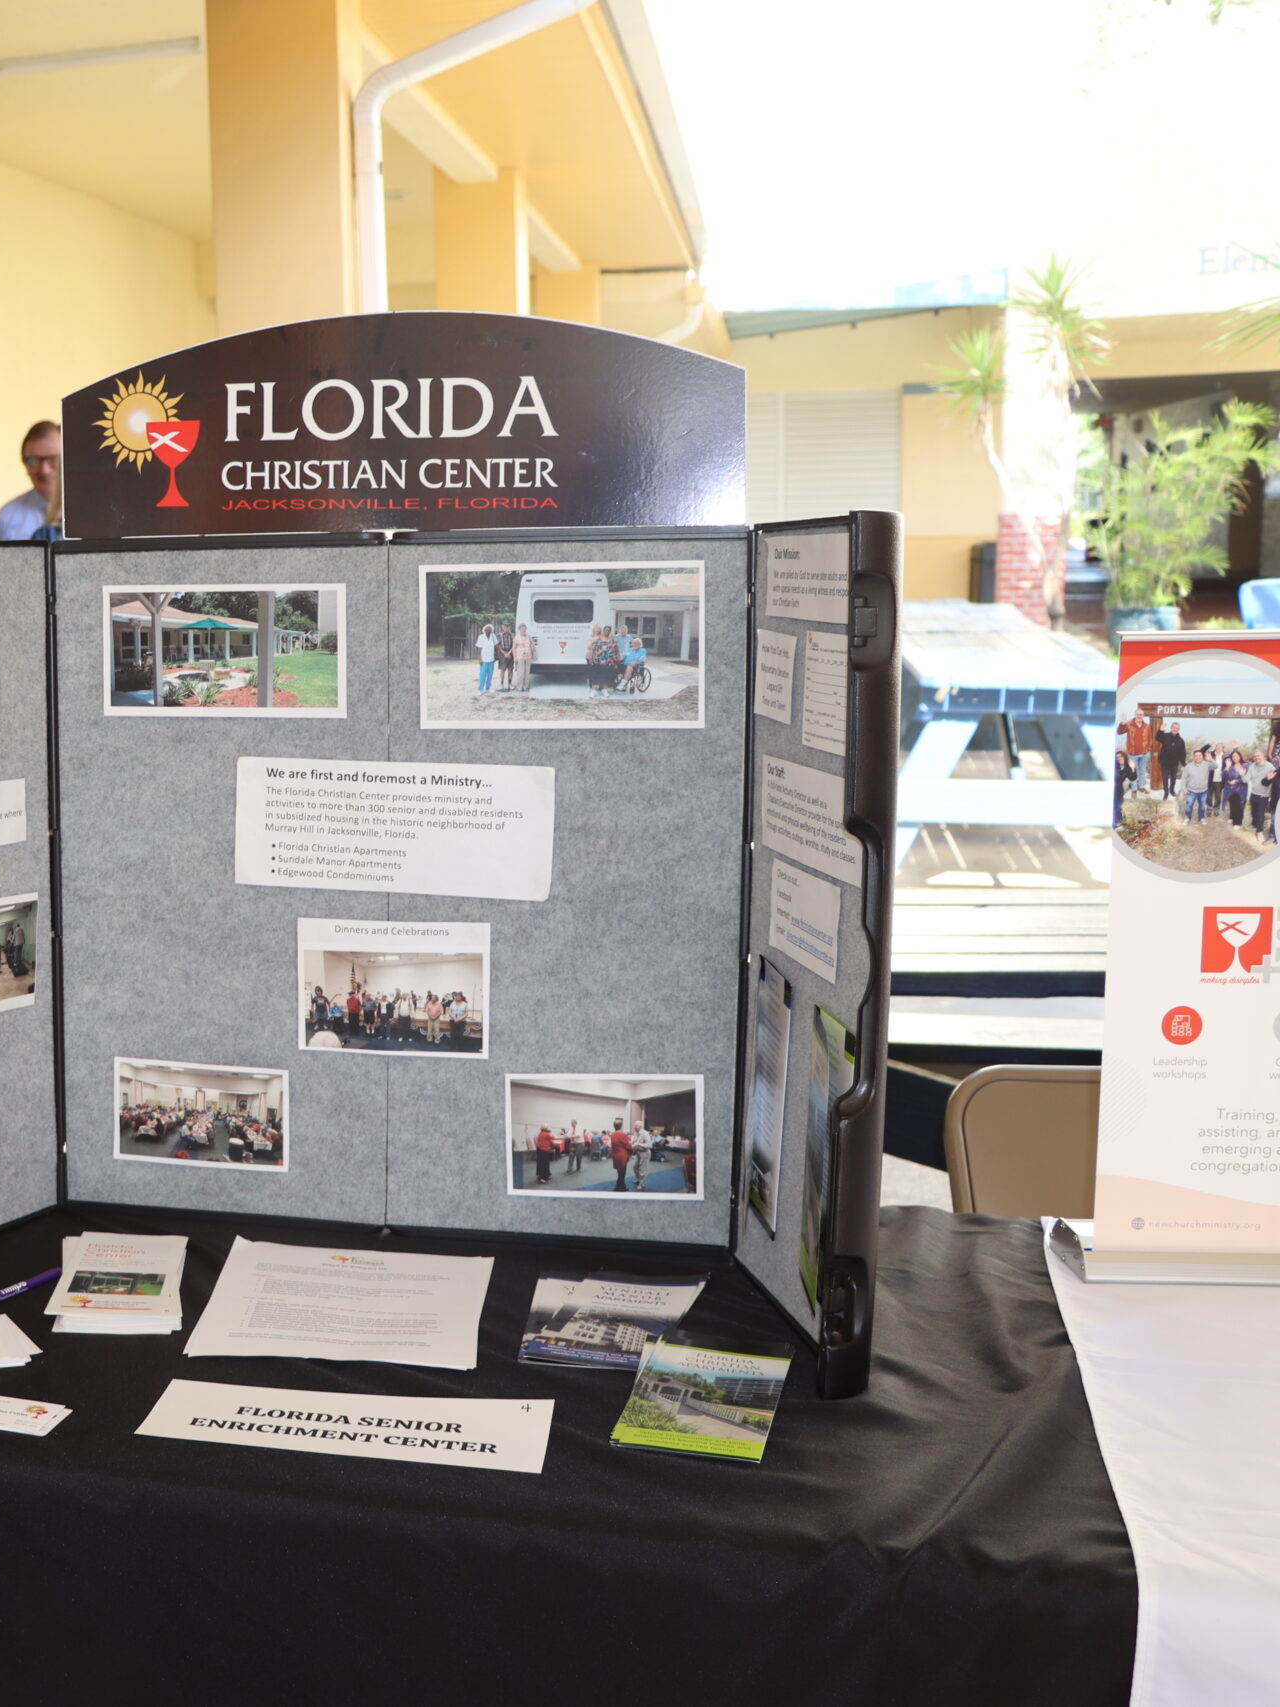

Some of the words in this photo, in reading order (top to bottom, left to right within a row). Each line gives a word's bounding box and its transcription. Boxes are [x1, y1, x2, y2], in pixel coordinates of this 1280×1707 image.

[224, 376, 559, 442] FLORIDA
[221, 459, 407, 491] CHRISTIAN
[419, 458, 559, 489] CENTER
[221, 498, 428, 512] JACKSONVILLE,
[438, 496, 558, 510] FLORIDA
[1157, 704, 1195, 715] PORTAL
[1208, 705, 1220, 716] OF
[1234, 706, 1275, 716] PRAYER
[266, 767, 285, 779] We
[288, 770, 308, 780] are
[310, 768, 334, 782] first
[336, 769, 359, 783] and
[361, 770, 417, 785] foremost
[420, 776, 427, 785] a
[430, 774, 493, 789] Ministry...
[266, 786, 282, 797] The
[284, 786, 315, 798] Florida
[317, 788, 357, 799] Christian
[359, 790, 390, 801] Center
[392, 792, 432, 805] provides
[434, 794, 472, 806] ministry
[474, 795, 493, 806] and
[4, 809, 23, 819] where
[265, 798, 305, 809] activities
[307, 800, 317, 809] to
[319, 802, 342, 811] more
[344, 801, 366, 812] than
[368, 803, 385, 814] 300
[387, 804, 416, 815] senior
[418, 805, 436, 816] and
[438, 806, 478, 818] disabled
[480, 808, 523, 819] residents
[265, 810, 274, 820] in
[275, 811, 322, 823] subsidized
[324, 812, 359, 826] housing
[361, 814, 370, 824] in
[372, 815, 388, 825] the
[390, 816, 424, 828] historic
[426, 817, 493, 832] neighborhood
[495, 820, 505, 831] of
[265, 823, 297, 836] Murray
[299, 824, 314, 834] Hill
[316, 825, 325, 835] in
[327, 826, 382, 839] Jacksonville,
[384, 828, 419, 840] Florida.
[278, 841, 309, 852] Florida
[311, 843, 351, 855] Christian
[353, 845, 407, 858] Apartments
[277, 854, 314, 865] Sundale
[316, 856, 346, 867] Manor
[348, 857, 402, 871] Apartments
[277, 867, 324, 880] Edgewood
[326, 869, 395, 883] Condominiums
[334, 925, 369, 935] Dinners
[371, 927, 389, 936] and
[391, 927, 450, 937] Celebrations
[1153, 1056, 1208, 1069] Leadership
[1152, 1070, 1207, 1081] workshops
[1216, 1108, 1278, 1125] Training,
[1198, 1126, 1262, 1141] assisting,
[1201, 1143, 1272, 1159] emerging
[1190, 1160, 1280, 1175] congregatio
[235, 1405, 351, 1426] FLORIDA
[357, 1416, 463, 1434] SENIOR
[187, 1416, 379, 1444] ENRICHMENT
[383, 1434, 498, 1454] CENTER
